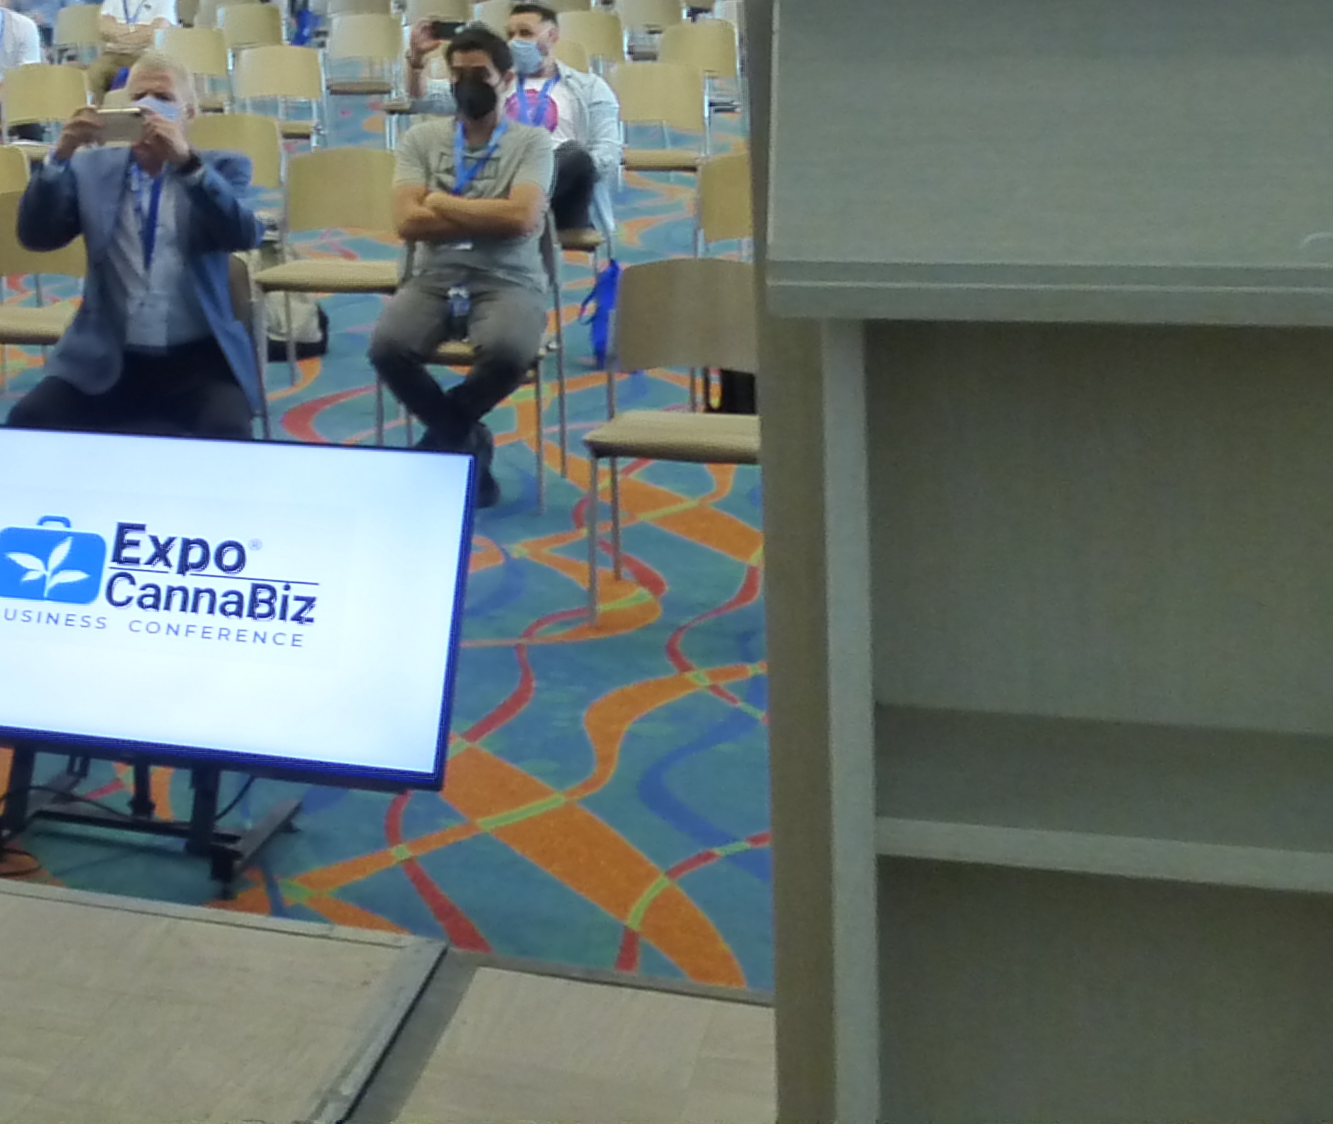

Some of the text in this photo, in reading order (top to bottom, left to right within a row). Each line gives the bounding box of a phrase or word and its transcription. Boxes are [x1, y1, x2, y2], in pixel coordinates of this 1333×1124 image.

[111, 521, 248, 576] Expo
[105, 570, 319, 626] CannaBiz
[128, 619, 305, 648] CONFERENCE
